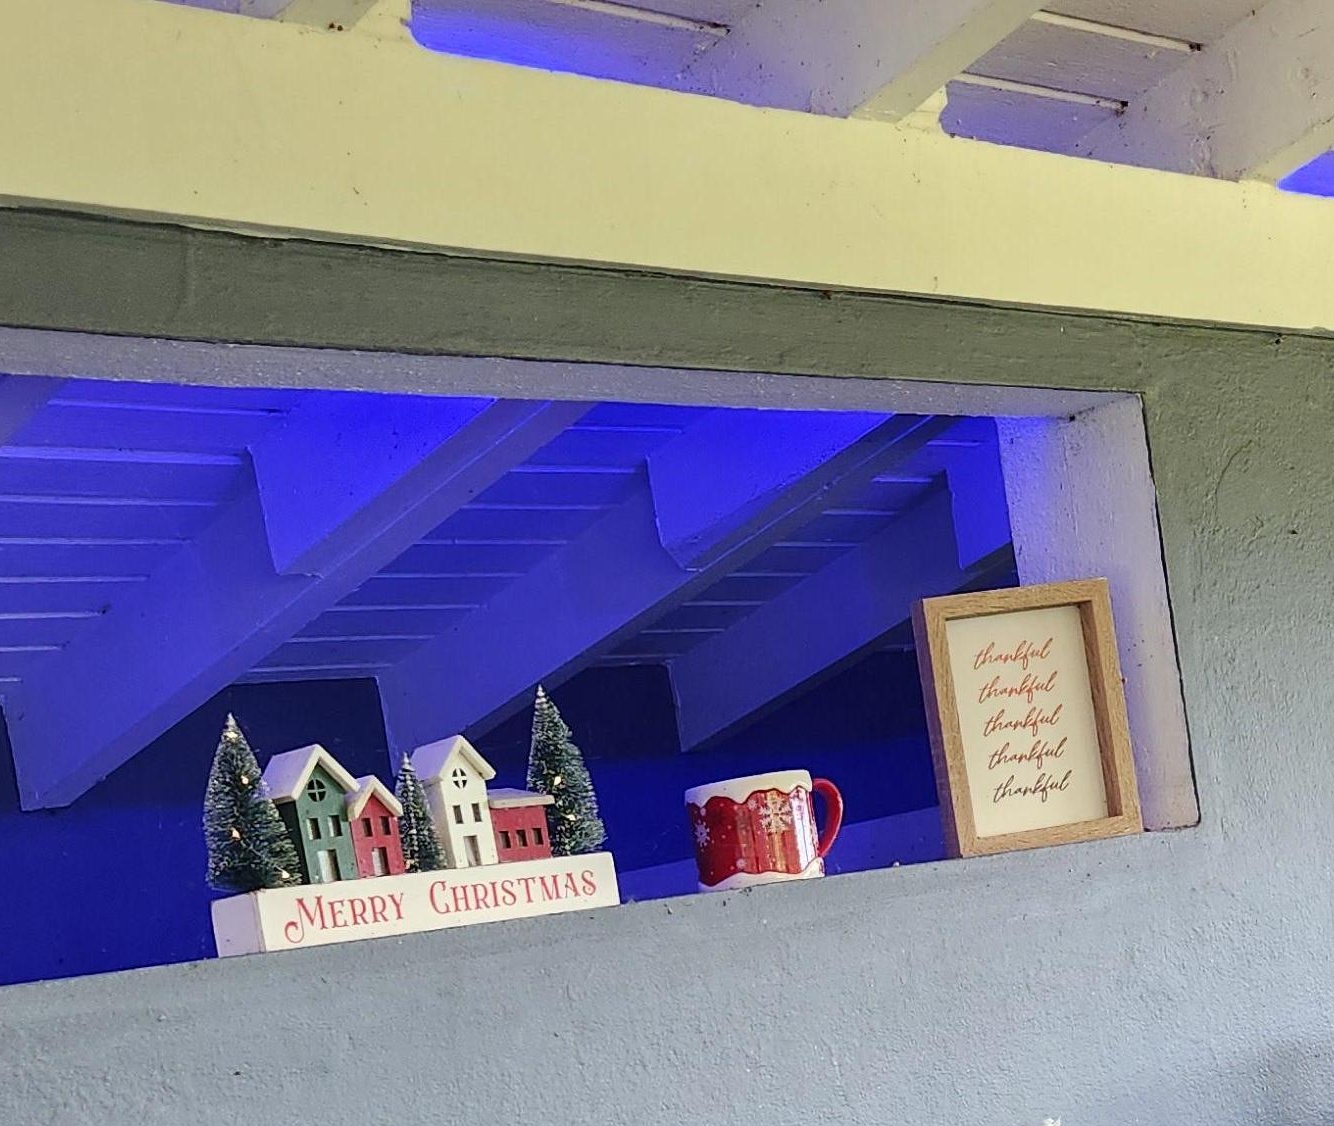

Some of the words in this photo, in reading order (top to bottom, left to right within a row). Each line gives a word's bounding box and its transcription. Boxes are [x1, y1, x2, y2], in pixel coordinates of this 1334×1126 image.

[973, 637, 1054, 671] thankful
[978, 671, 1058, 705] thankful
[983, 703, 1063, 738] thankful
[988, 737, 1068, 771] thankful
[992, 769, 1073, 804] thankful
[284, 891, 405, 944] MERRY
[428, 869, 599, 916] CHRISTMAS
